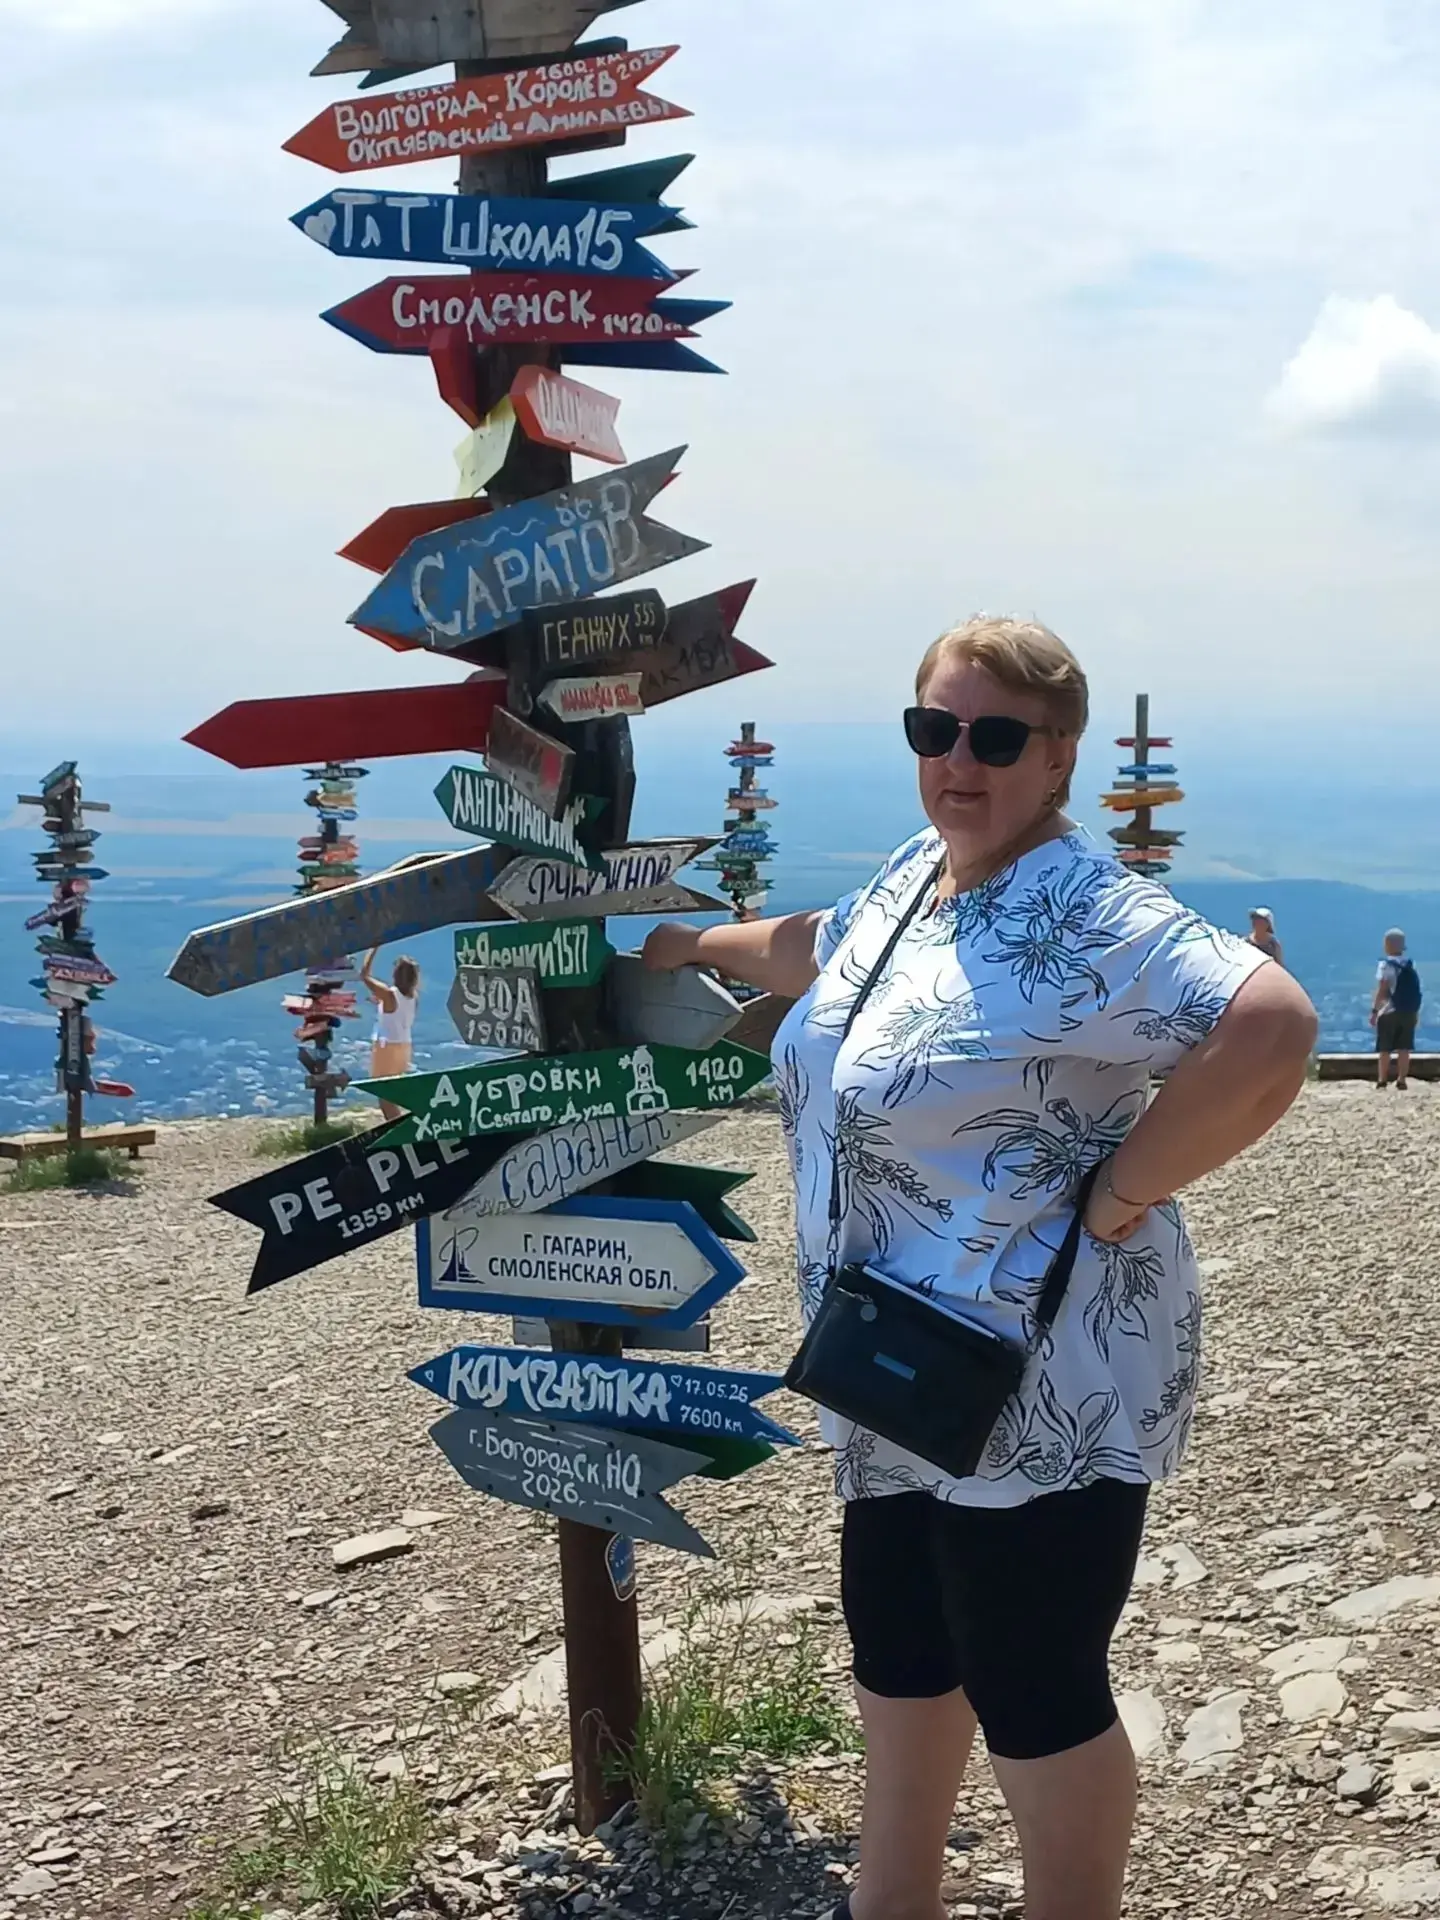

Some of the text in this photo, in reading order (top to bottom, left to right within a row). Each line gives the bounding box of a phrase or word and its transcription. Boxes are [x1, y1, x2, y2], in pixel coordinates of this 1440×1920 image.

[411, 478, 640, 638] САРАТОВ
[542, 612, 632, 663] ГЕДЖУХ
[633, 603, 656, 627] 555
[460, 971, 540, 1026] УФА
[686, 1055, 744, 1087] 1420
[337, 1202, 393, 1238] 1359
[523, 1234, 633, 1264] Г. ГАГАРИН,
[488, 1256, 679, 1291] СМОЛЕНСКАЯ ОБЛ.
[685, 1378, 748, 1403] 17.05.26
[680, 1404, 722, 1429] 7600
